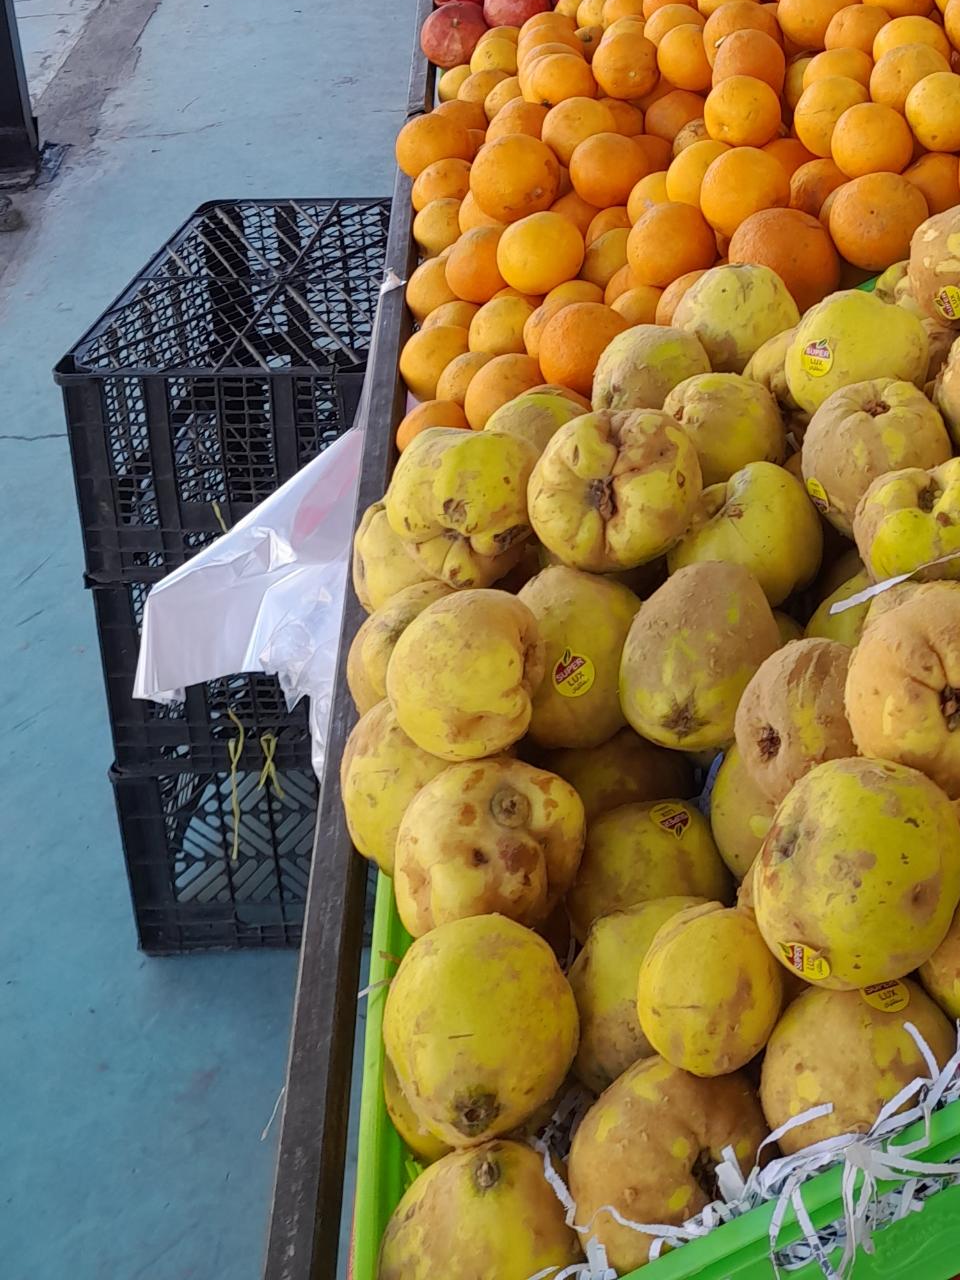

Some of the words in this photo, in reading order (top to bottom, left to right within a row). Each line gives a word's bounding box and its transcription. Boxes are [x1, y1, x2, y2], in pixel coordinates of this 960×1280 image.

[941, 290, 954, 317] SUPER
[950, 294, 959, 309] LUX
[806, 346, 830, 358] SUPER
[810, 358, 823, 367] LUX
[555, 657, 586, 682] SUPER
[567, 670, 585, 687] LUX
[663, 812, 689, 827] SUPER
[793, 944, 803, 971] SUPER
[878, 989, 898, 1001] LUX
